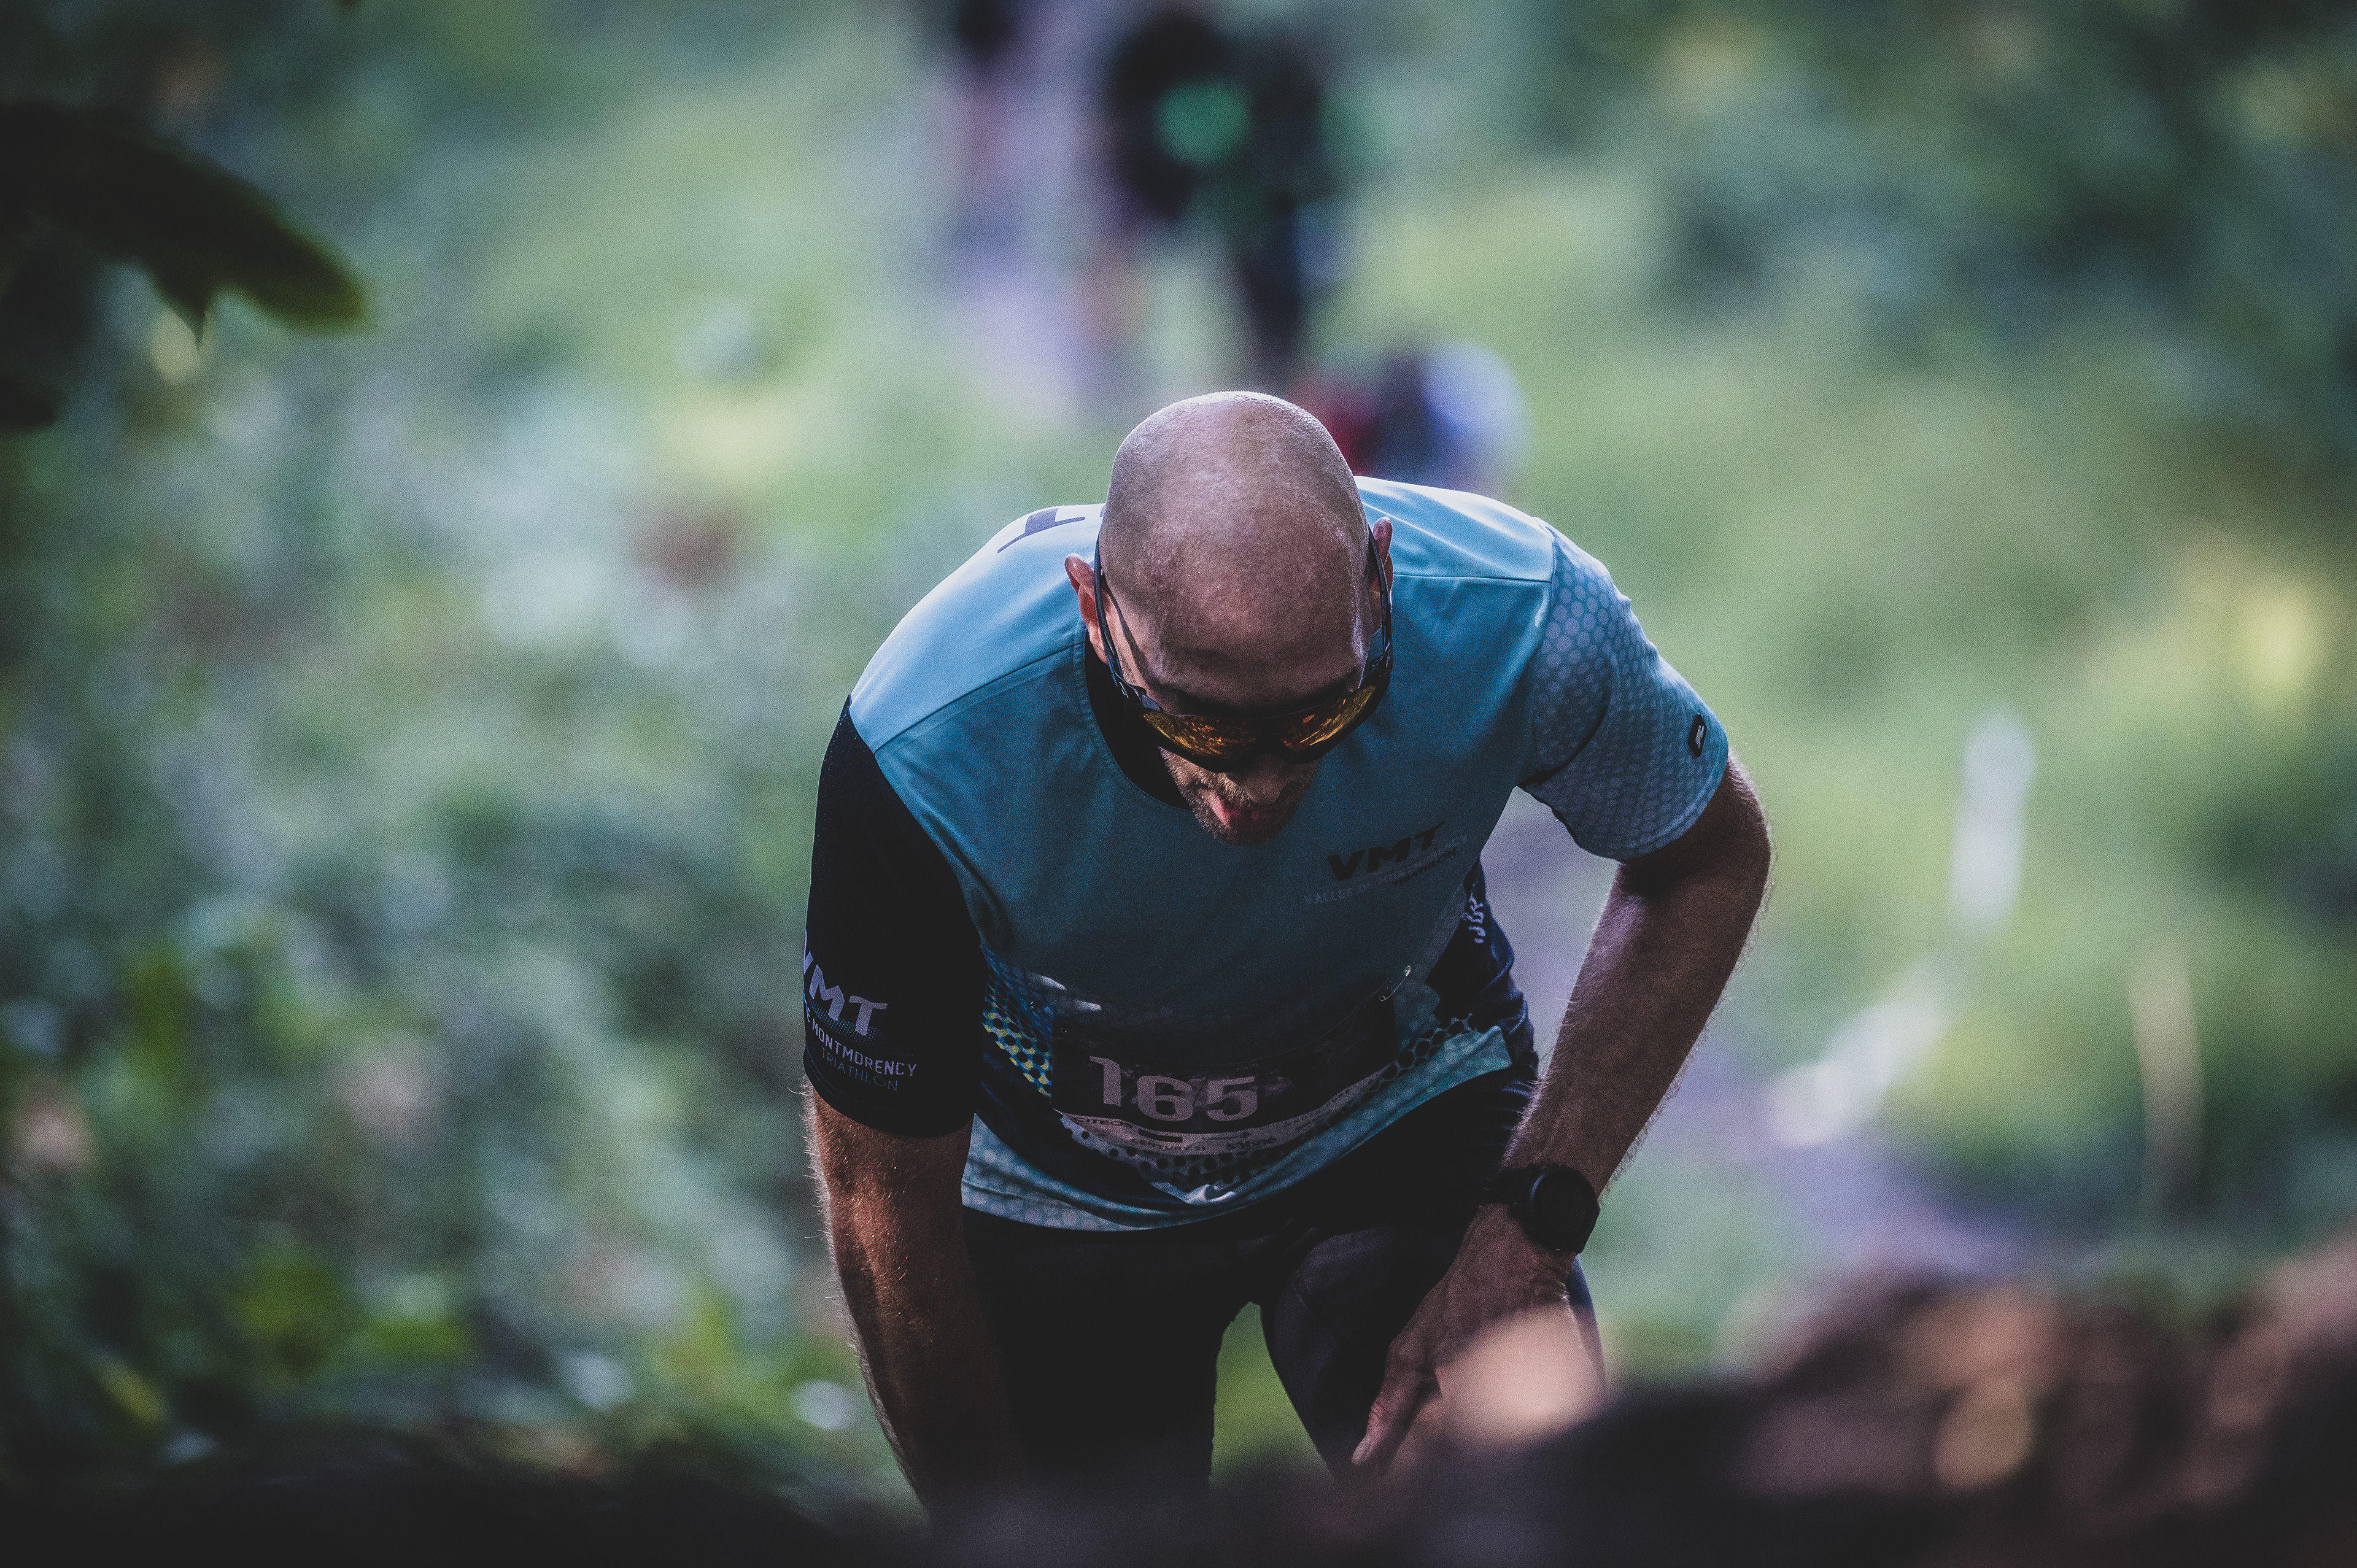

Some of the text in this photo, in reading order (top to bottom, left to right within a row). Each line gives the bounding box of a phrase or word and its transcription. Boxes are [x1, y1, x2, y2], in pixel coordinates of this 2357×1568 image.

[1327, 820, 1446, 881] VMT
[1393, 848, 1457, 887] TRIATHLON
[811, 1019, 917, 1078] MONTMORENCY
[821, 1046, 899, 1092] TRIATHLON
[1089, 1055, 1258, 1122] 165
